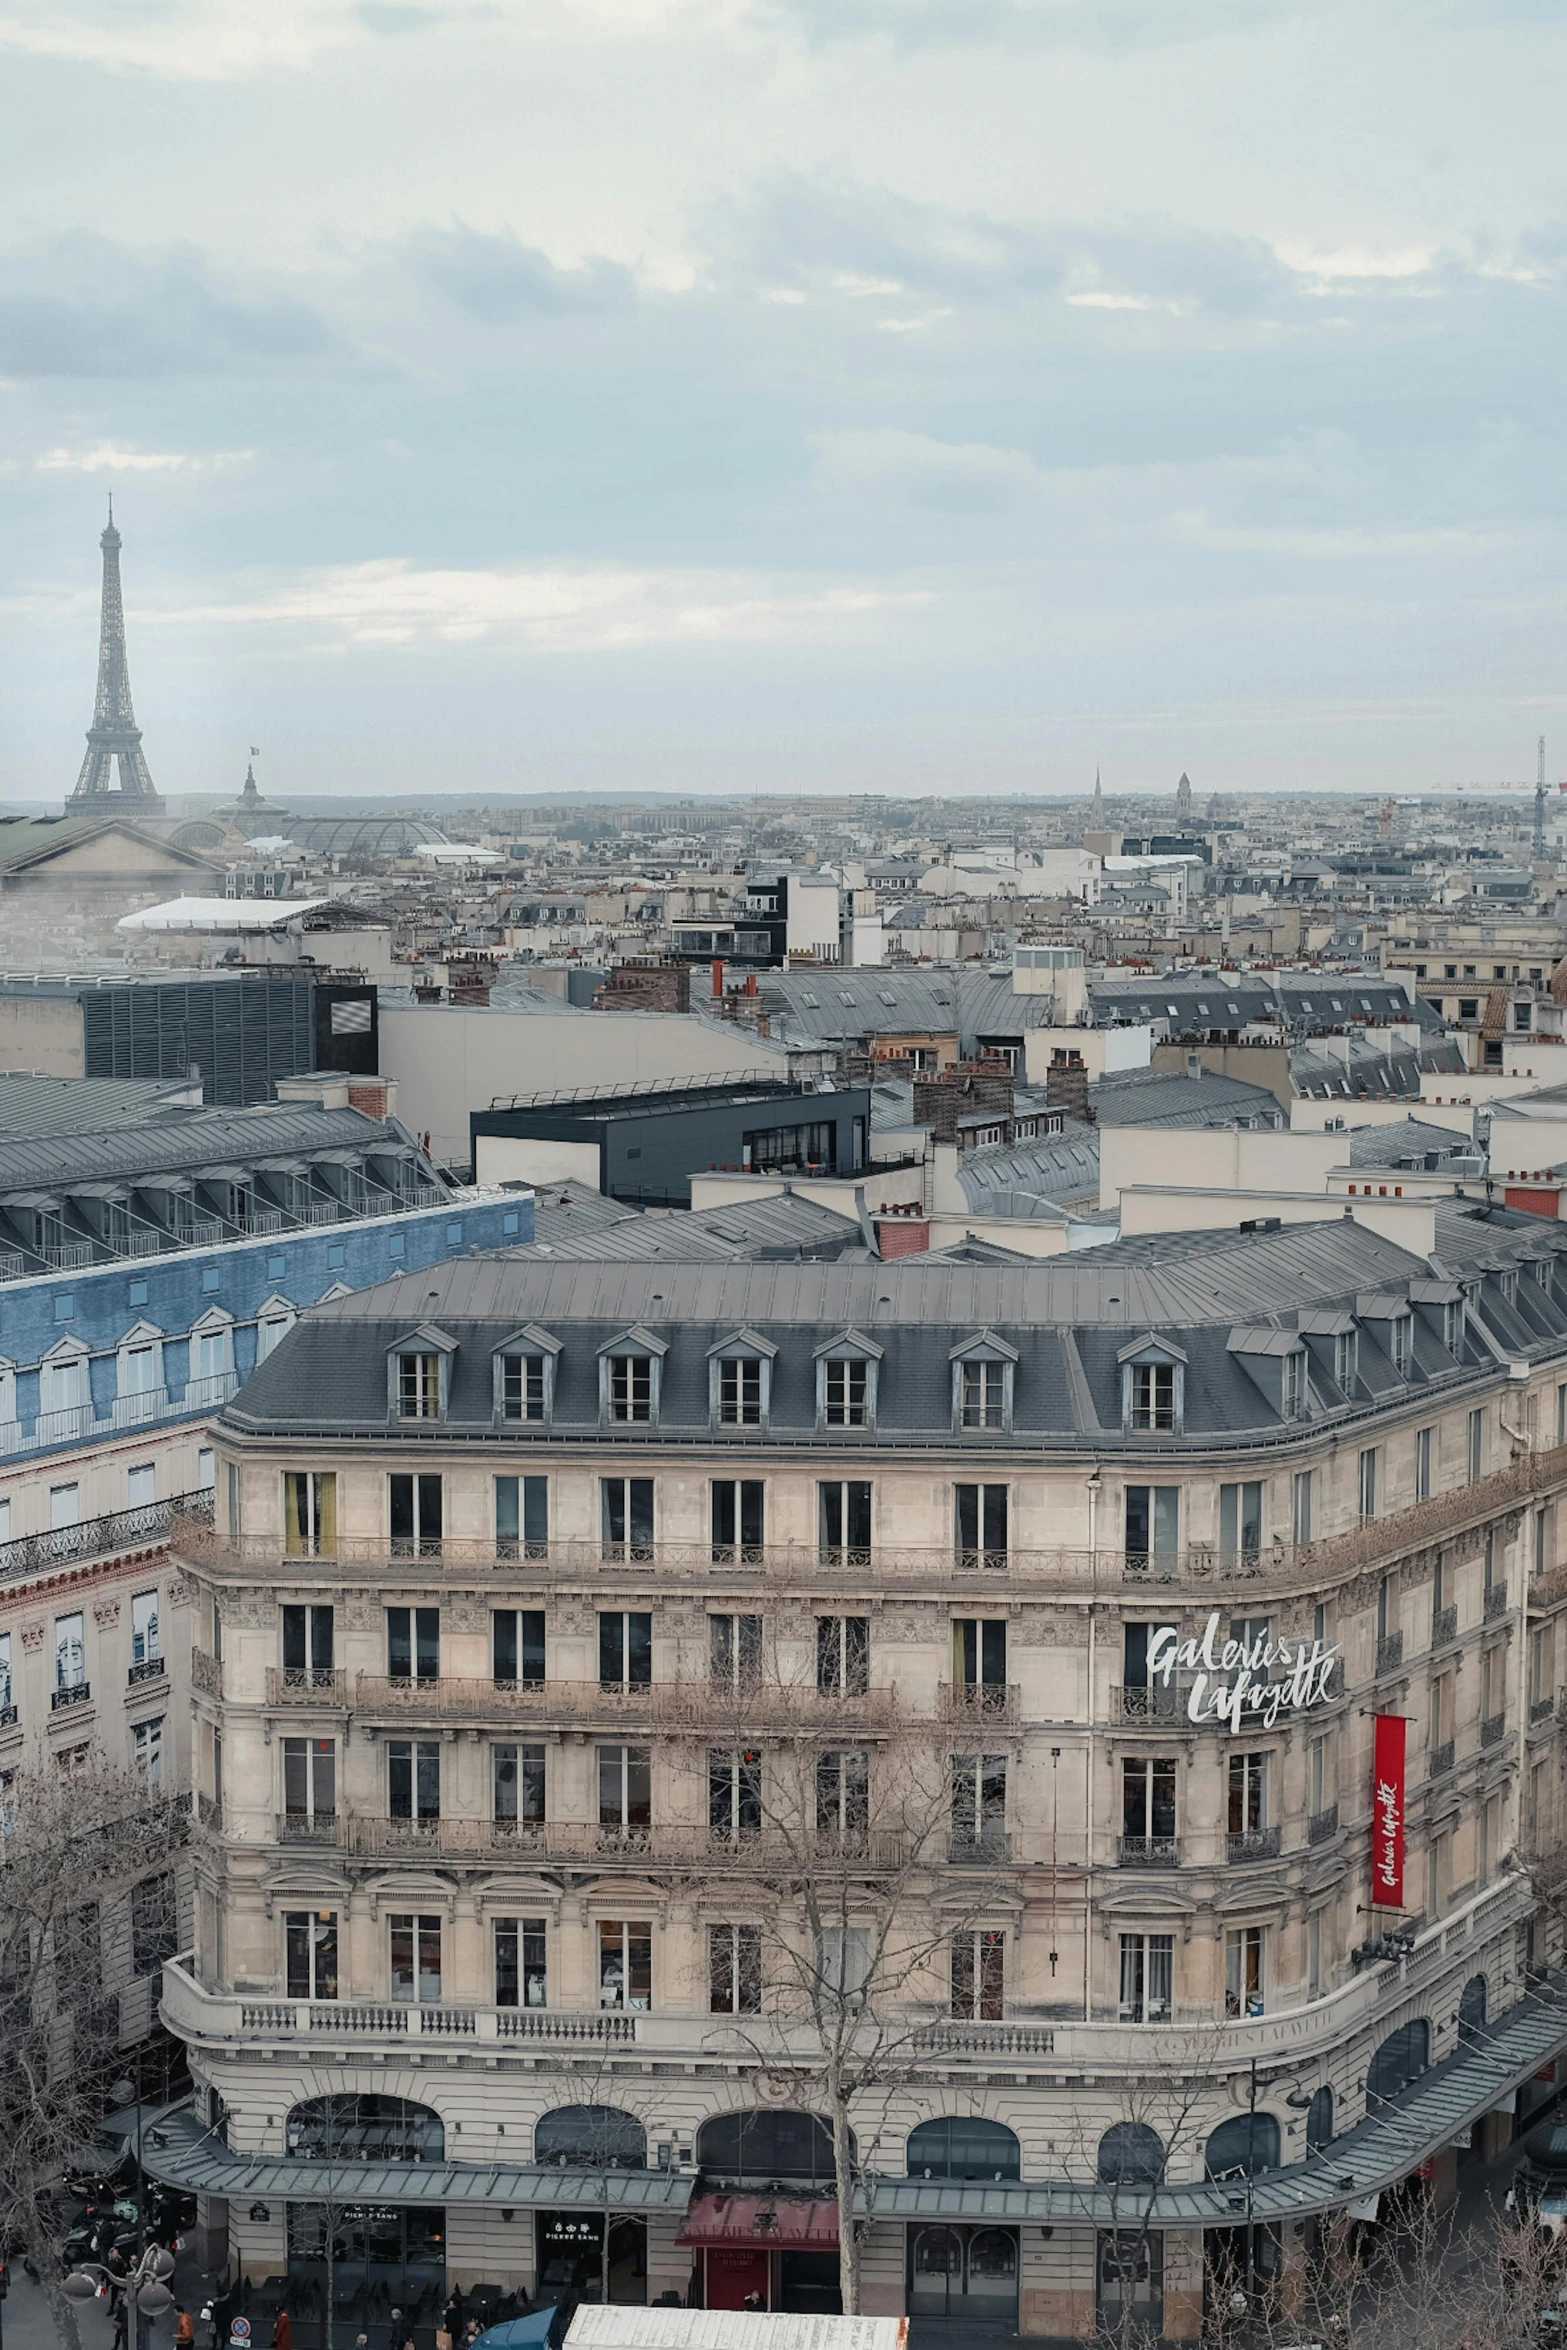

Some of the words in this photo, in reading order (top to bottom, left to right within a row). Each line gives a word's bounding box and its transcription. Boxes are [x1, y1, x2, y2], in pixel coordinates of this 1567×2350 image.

[1146, 1612, 1293, 1687] Galeries
[1187, 1639, 1343, 1733] Lafayette
[1377, 1779, 1400, 1837] Lafayette
[1377, 1840, 1399, 1886] Galeries
[1260, 2010, 1332, 2043] LAFAYETTE
